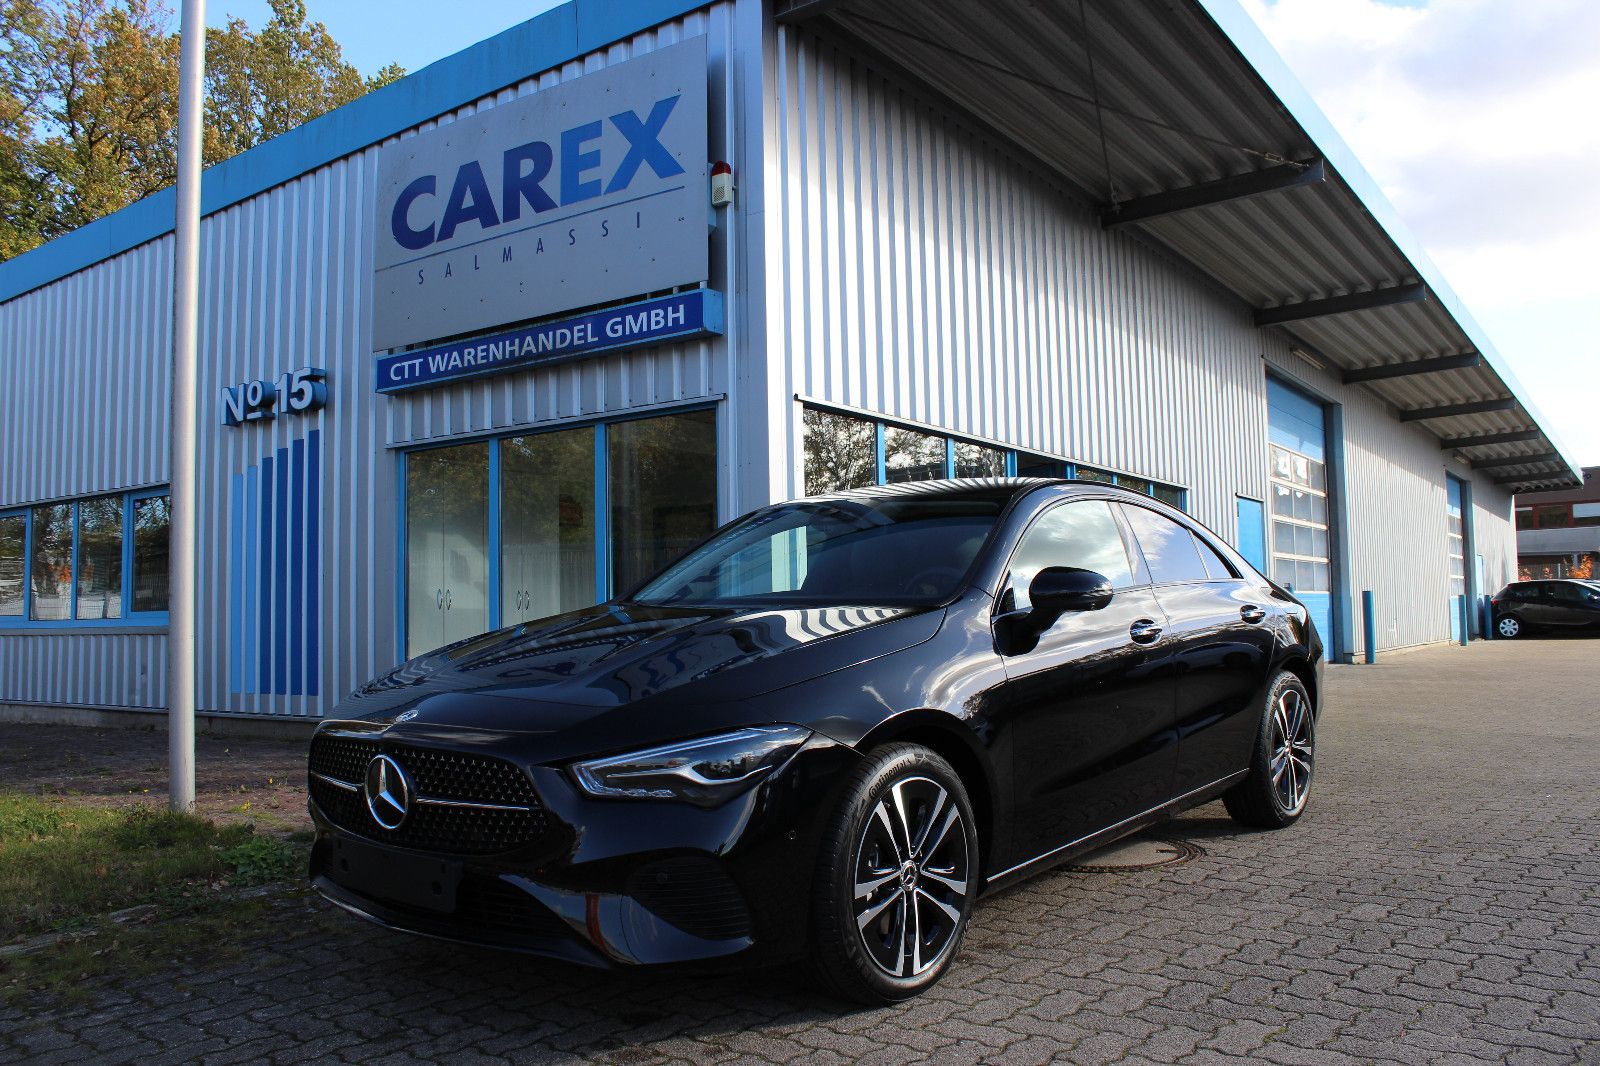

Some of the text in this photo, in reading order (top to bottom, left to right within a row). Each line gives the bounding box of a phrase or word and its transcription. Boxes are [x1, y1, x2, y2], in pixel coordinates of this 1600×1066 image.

[391, 94, 686, 250] CAREX
[418, 212, 640, 285] SALMASSI
[390, 304, 685, 381] CTT WARENHANDEL GMBH
[275, 367, 320, 413] 15
